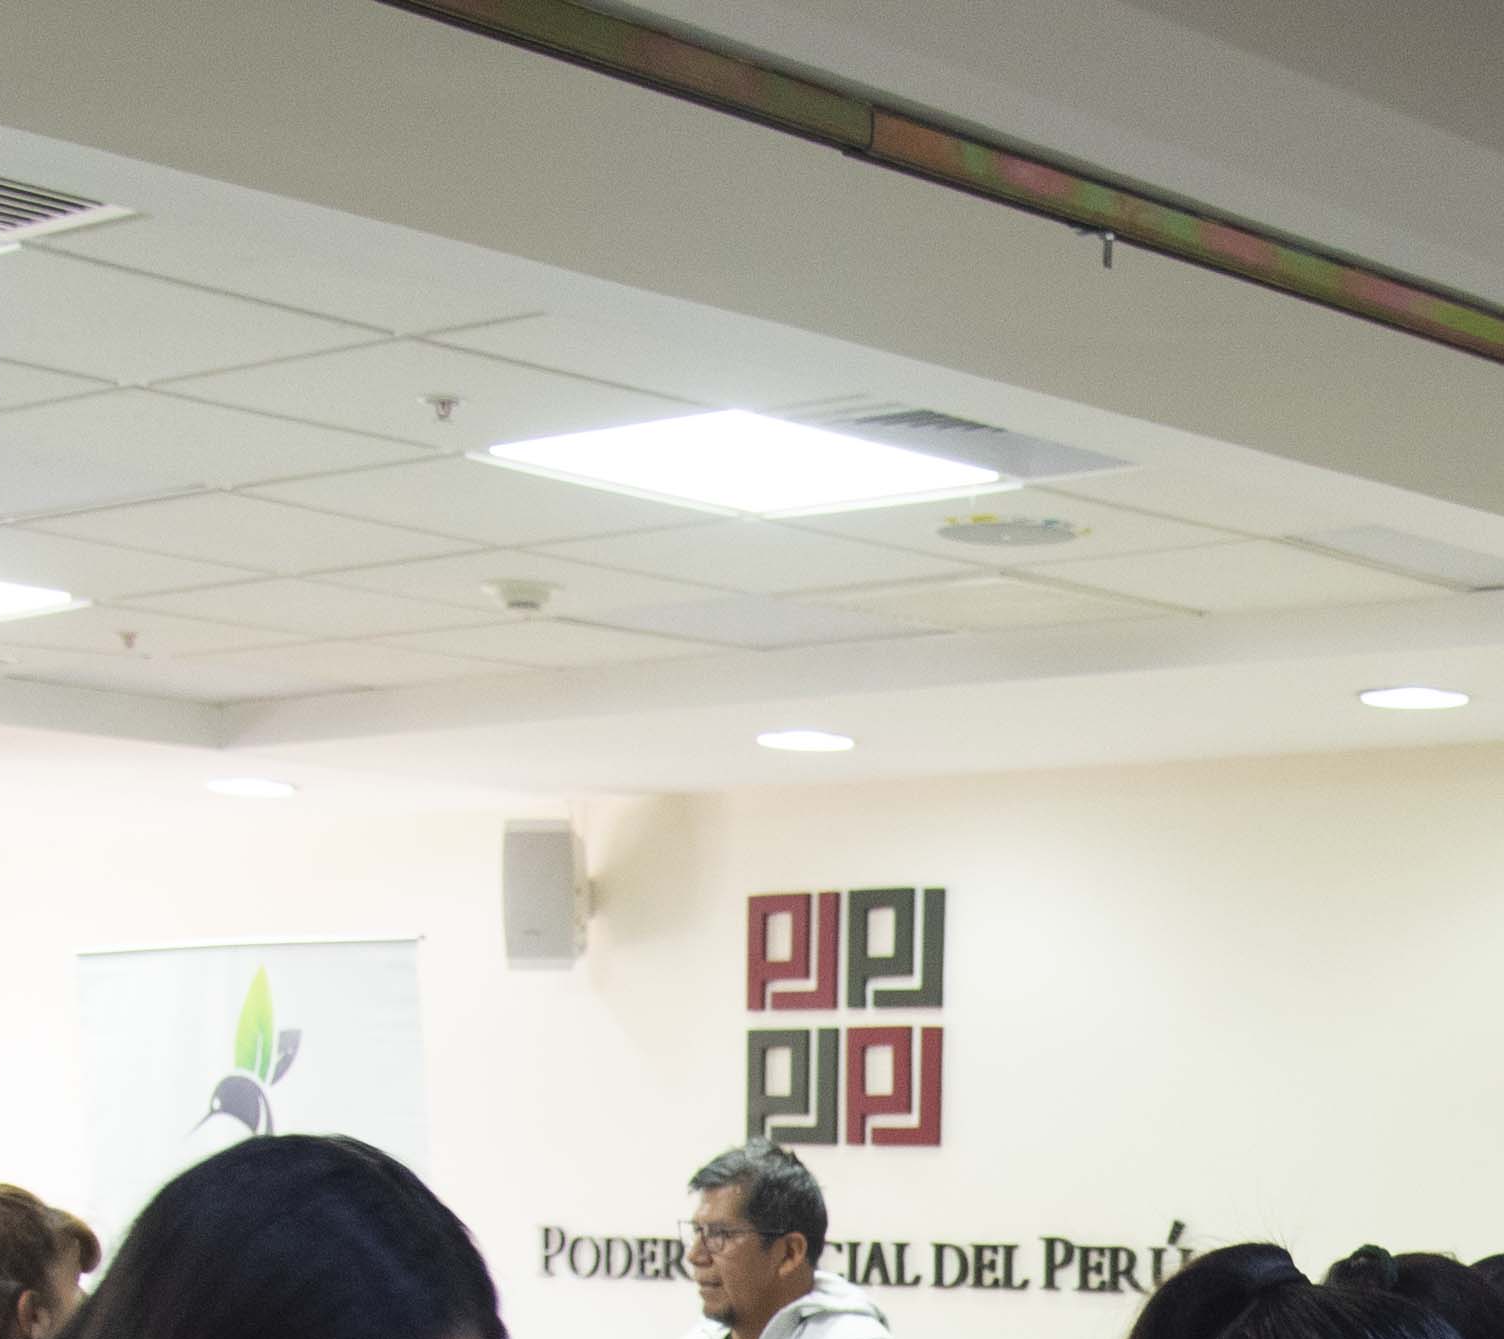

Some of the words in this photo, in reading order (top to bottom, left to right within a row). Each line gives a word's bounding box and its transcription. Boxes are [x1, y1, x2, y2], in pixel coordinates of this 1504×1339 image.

[539, 1225, 694, 1281] PODER
[930, 1242, 1029, 1289] DEL
[1039, 1219, 1196, 1295] PERÚ
